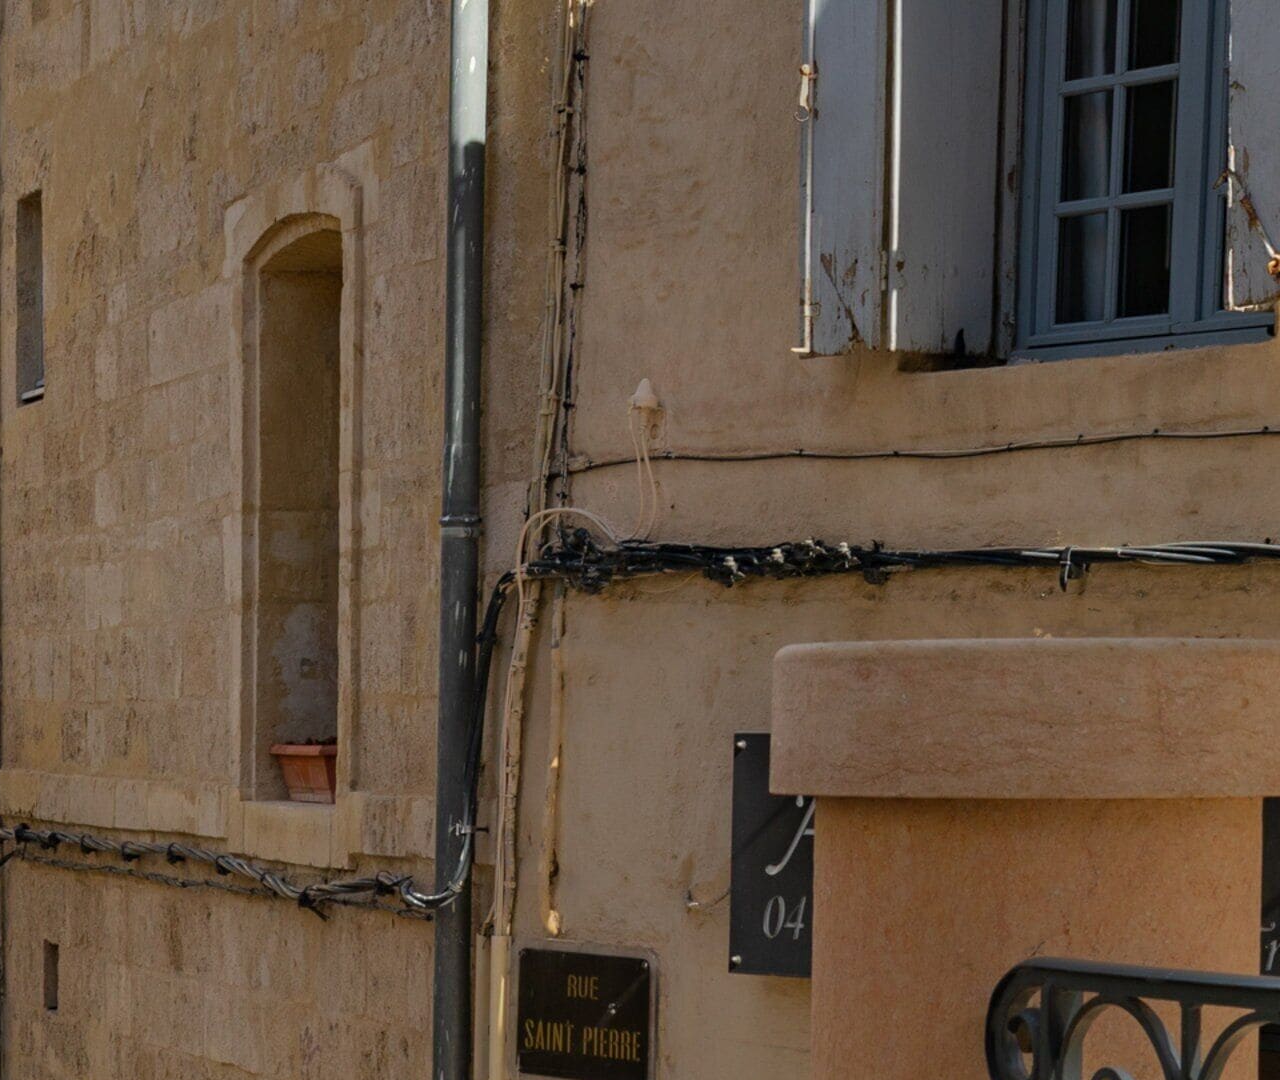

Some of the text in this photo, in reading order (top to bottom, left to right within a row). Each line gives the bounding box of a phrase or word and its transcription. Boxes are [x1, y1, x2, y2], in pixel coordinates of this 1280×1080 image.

[762, 895, 807, 940] 04
[567, 974, 599, 1000] RUE
[524, 1019, 641, 1062] SAINT PIERRE
